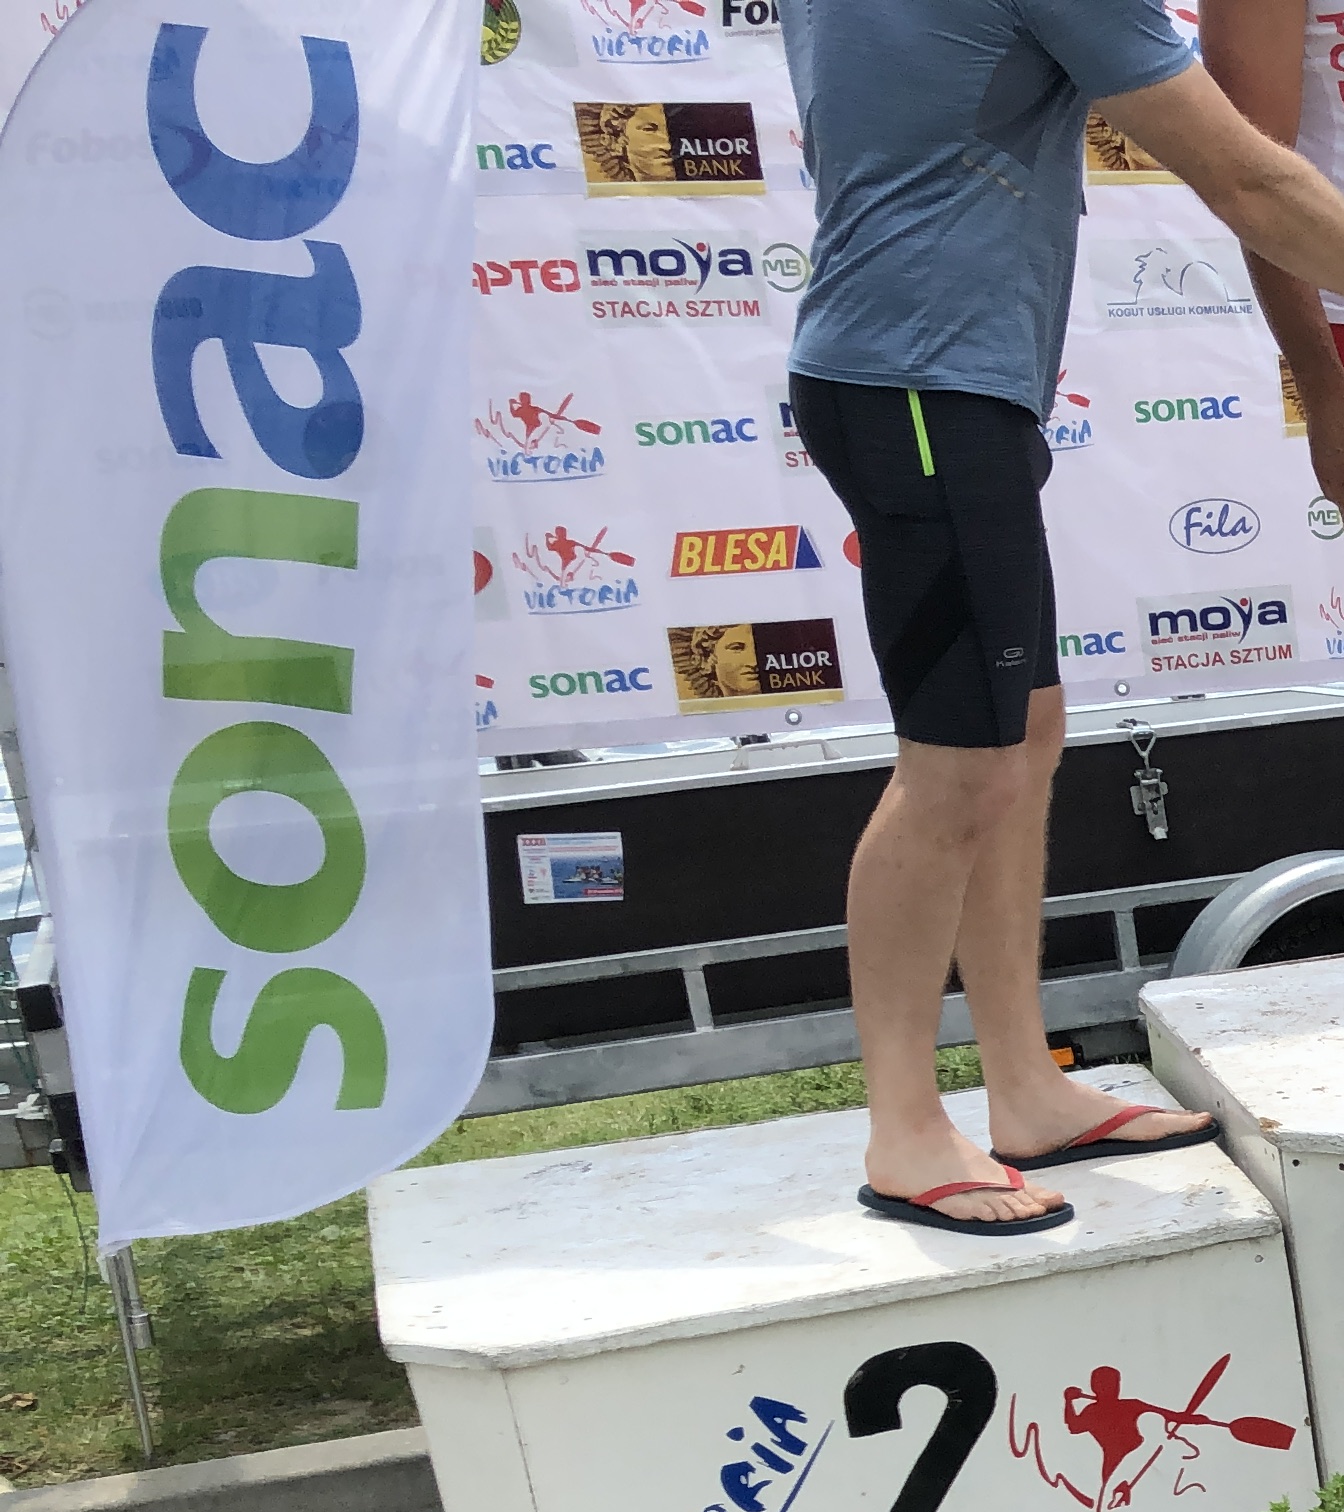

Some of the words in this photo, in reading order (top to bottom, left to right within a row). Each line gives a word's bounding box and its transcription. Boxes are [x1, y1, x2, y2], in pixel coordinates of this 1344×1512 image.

[680, 138, 751, 156] ALIOR
[684, 159, 744, 176] BANK
[592, 300, 680, 318] STACJA
[686, 300, 761, 317] SZTUM
[1108, 307, 1142, 317] KOGUT
[1188, 304, 1253, 315] KOMUNALNE
[1134, 394, 1243, 423] sonac
[635, 417, 758, 447] sonac
[678, 531, 790, 575] BLESA
[147, 22, 388, 1114] sonac
[765, 650, 833, 671] ALIOR
[1151, 651, 1225, 672] STACJA
[1230, 644, 1293, 665] SZTUM
[529, 666, 653, 699] sonac
[769, 669, 826, 689] BANK
